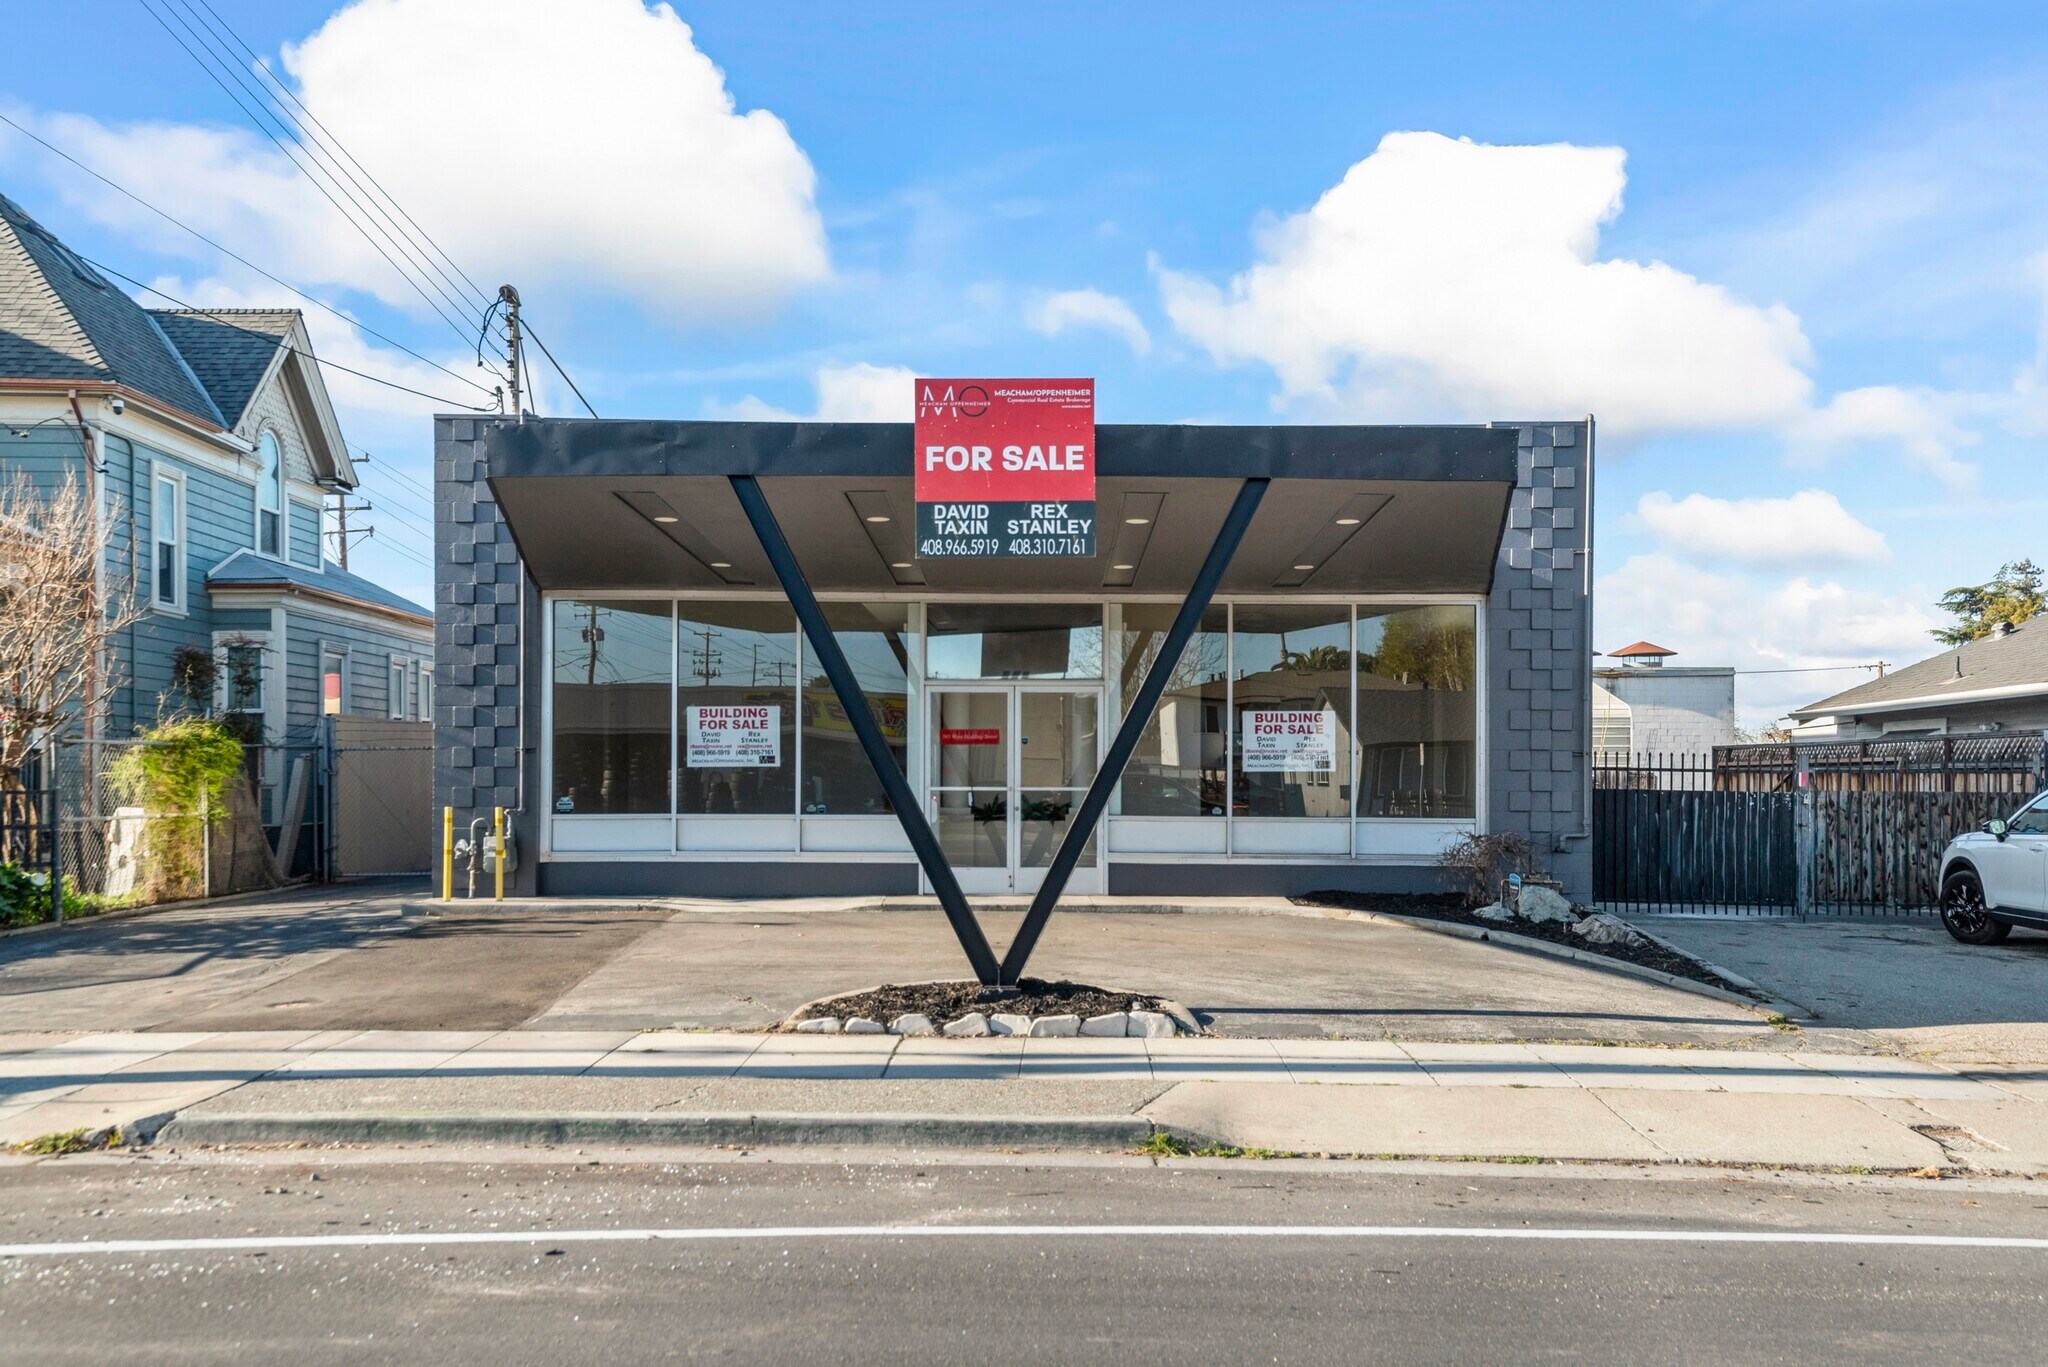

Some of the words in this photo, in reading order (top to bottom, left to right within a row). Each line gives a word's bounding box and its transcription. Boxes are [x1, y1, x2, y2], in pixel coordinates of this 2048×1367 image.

[994, 389, 1091, 397] MEACHAM/OPPENHEIMER
[926, 445, 992, 472] FOR
[1002, 445, 1084, 471] SALE
[934, 504, 989, 519] DAVID
[1031, 504, 1068, 518] REX
[935, 520, 988, 535] TAXIN
[1007, 519, 1092, 534] STANLEY
[921, 538, 999, 555] 408.966.5919
[1008, 538, 1086, 555] 408.310.7161
[699, 708, 768, 718] BUILDING
[1254, 713, 1323, 723] BUILDING
[699, 720, 728, 730] FOR
[732, 719, 769, 730] SALE
[1254, 724, 1283, 735] FOR
[1287, 724, 1324, 734] SALE
